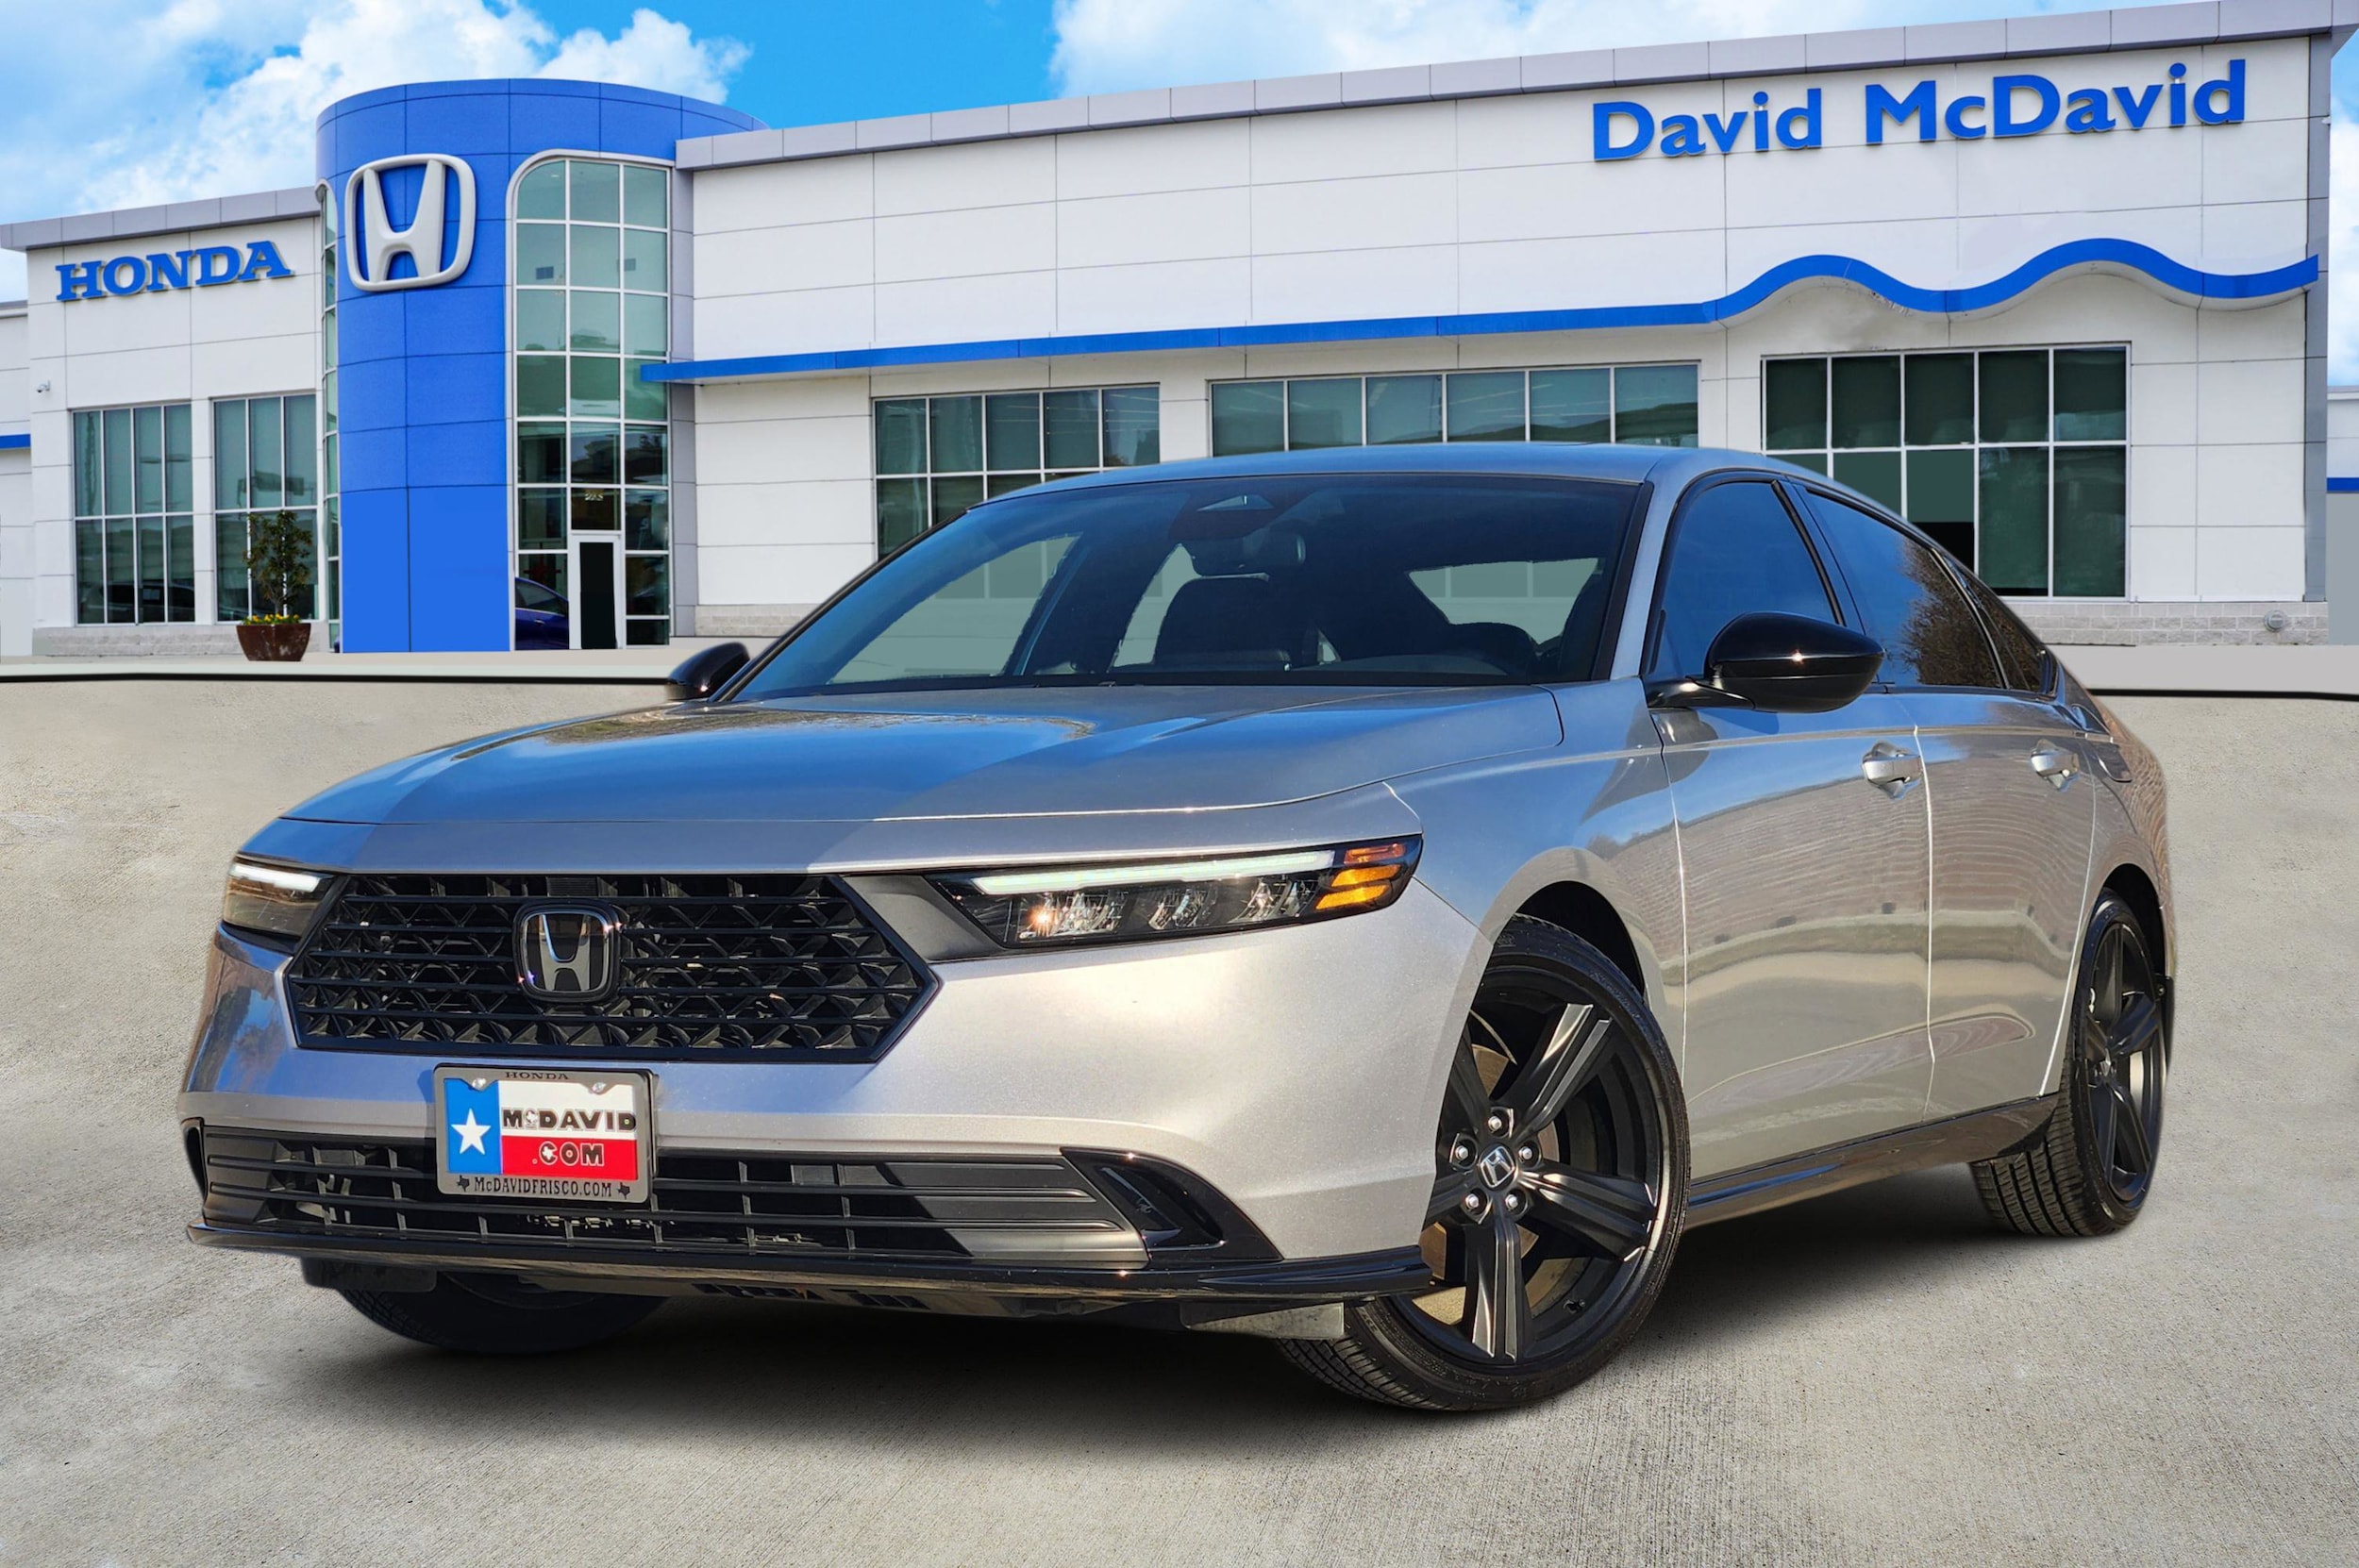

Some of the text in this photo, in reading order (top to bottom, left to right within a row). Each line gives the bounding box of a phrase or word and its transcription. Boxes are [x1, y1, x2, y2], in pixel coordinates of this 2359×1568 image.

[1593, 59, 2246, 161] David McDavid
[56, 240, 294, 302] HONDA
[505, 1070, 569, 1080] HONDA
[474, 1176, 612, 1197] McDAVIDFRISCO.COM
